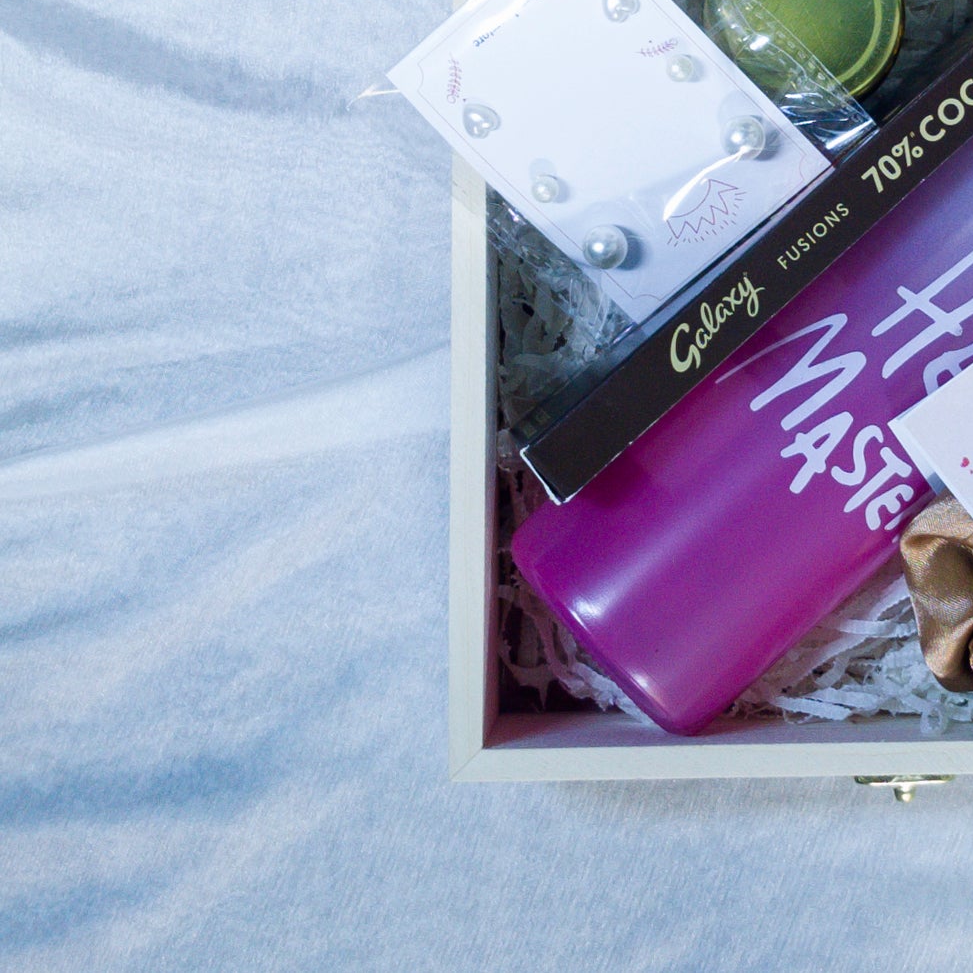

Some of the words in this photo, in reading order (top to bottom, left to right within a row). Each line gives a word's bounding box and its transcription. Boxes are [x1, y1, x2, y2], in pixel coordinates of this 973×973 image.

[670, 273, 766, 373] Galaxy
[777, 202, 850, 271] FUSIONS
[861, 134, 924, 194] 70%
